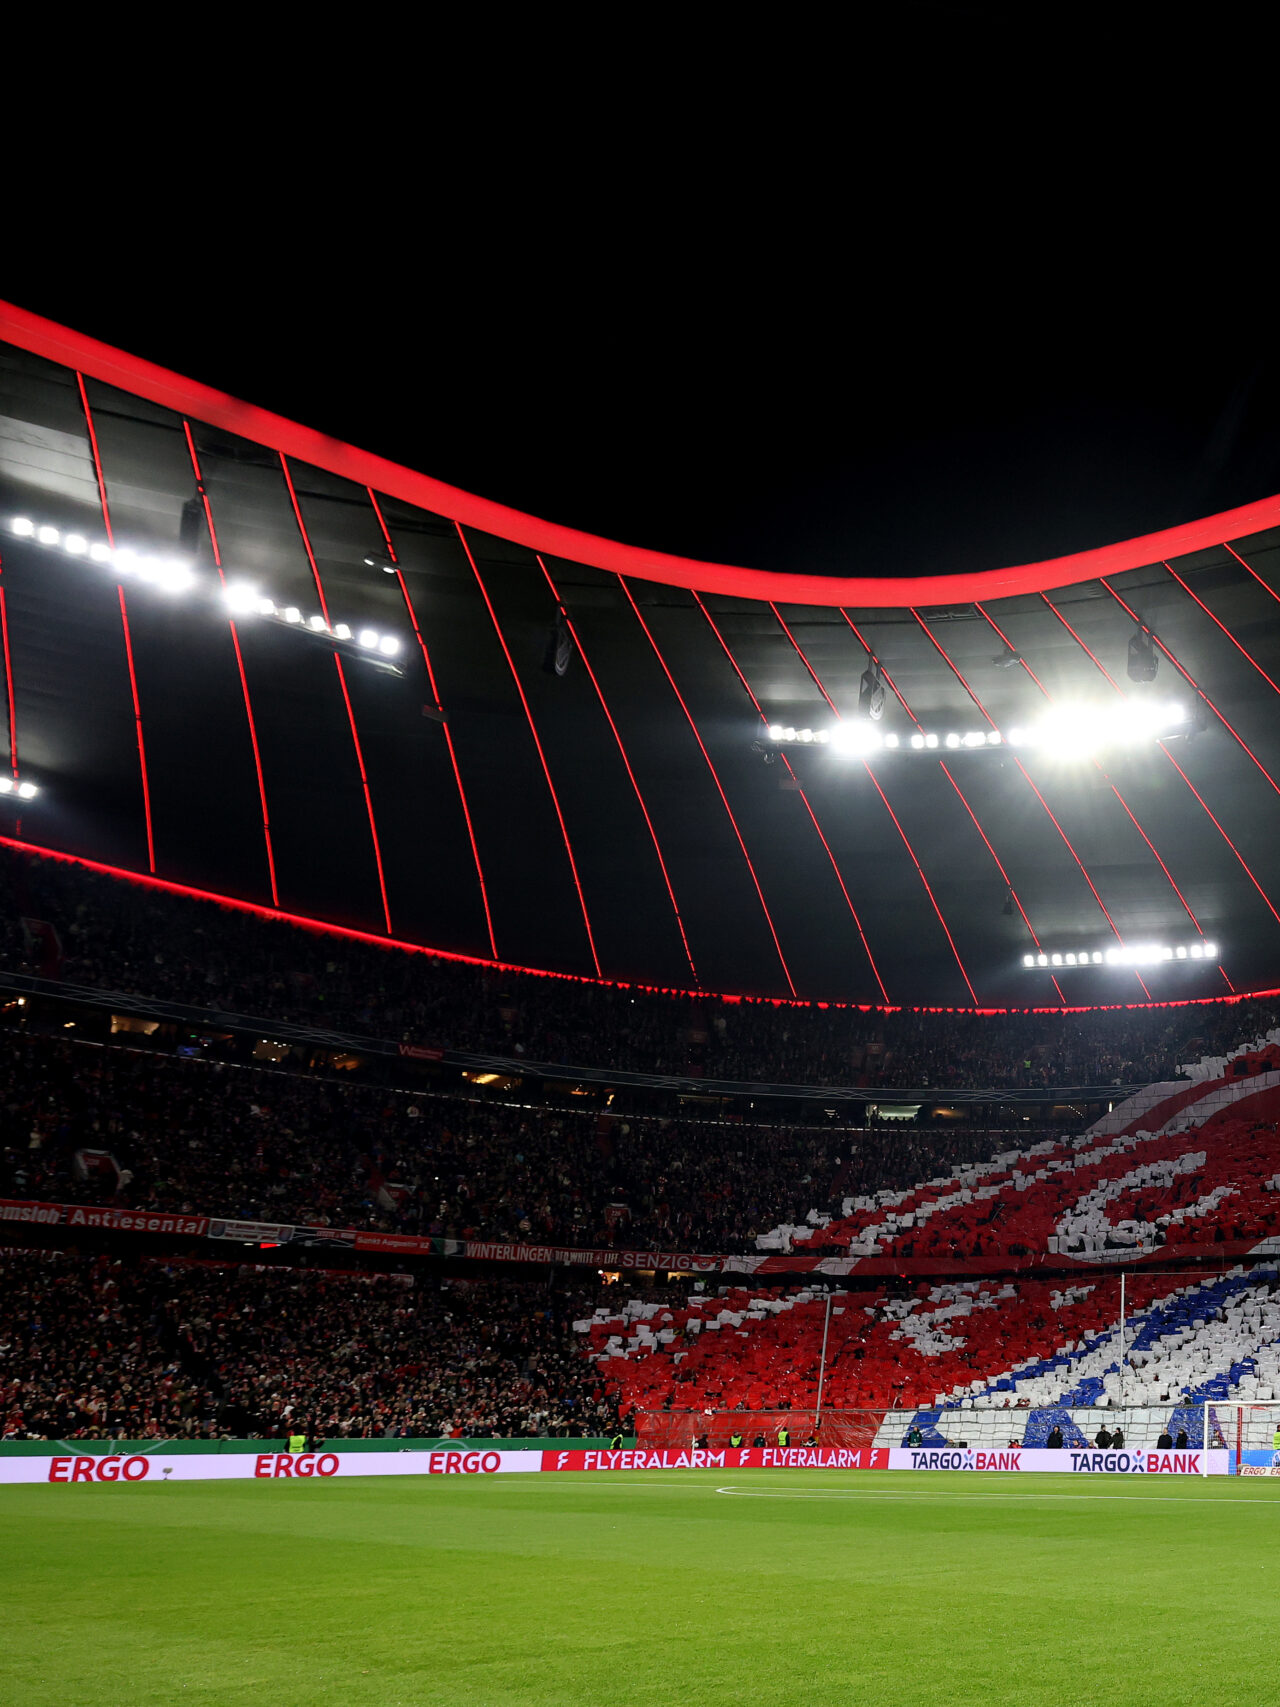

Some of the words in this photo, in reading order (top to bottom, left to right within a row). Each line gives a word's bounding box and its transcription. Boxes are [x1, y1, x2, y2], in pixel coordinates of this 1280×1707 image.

[71, 1209, 206, 1235] Antiesental
[466, 1243, 551, 1263] WINTERLINGEN
[570, 1251, 594, 1264] WHITE
[623, 1253, 690, 1269] SENZIG
[255, 1453, 340, 1478] ERGO
[429, 1451, 501, 1475] ERGO
[583, 1450, 726, 1470] FLYERALARM
[762, 1448, 861, 1468] FLYERALARM
[48, 1456, 149, 1483] ERGO
[1243, 1467, 1266, 1476] ERGO
